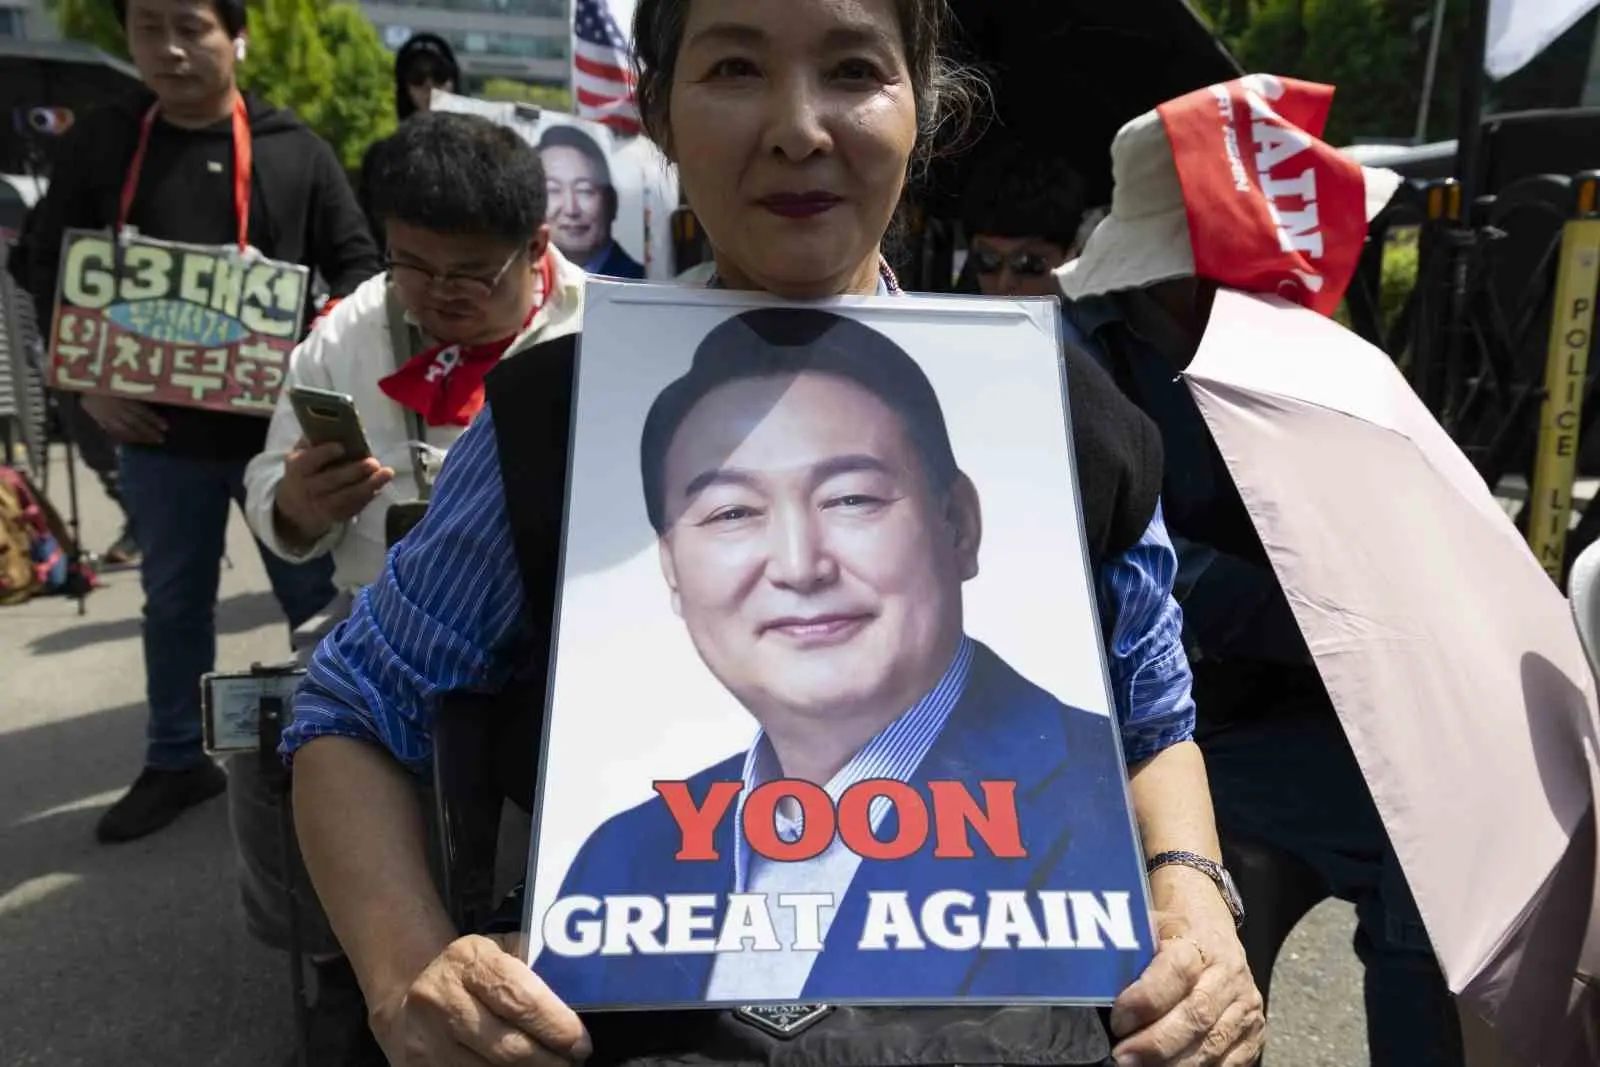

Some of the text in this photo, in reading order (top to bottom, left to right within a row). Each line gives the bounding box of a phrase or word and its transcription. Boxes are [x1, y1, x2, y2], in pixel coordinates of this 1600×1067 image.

[180, 253, 299, 336] 대선
[57, 314, 284, 409] 원천무효
[1557, 298, 1588, 457] POLICE
[652, 779, 1027, 862] YOON
[541, 890, 1140, 956] GREAT AGAIN
